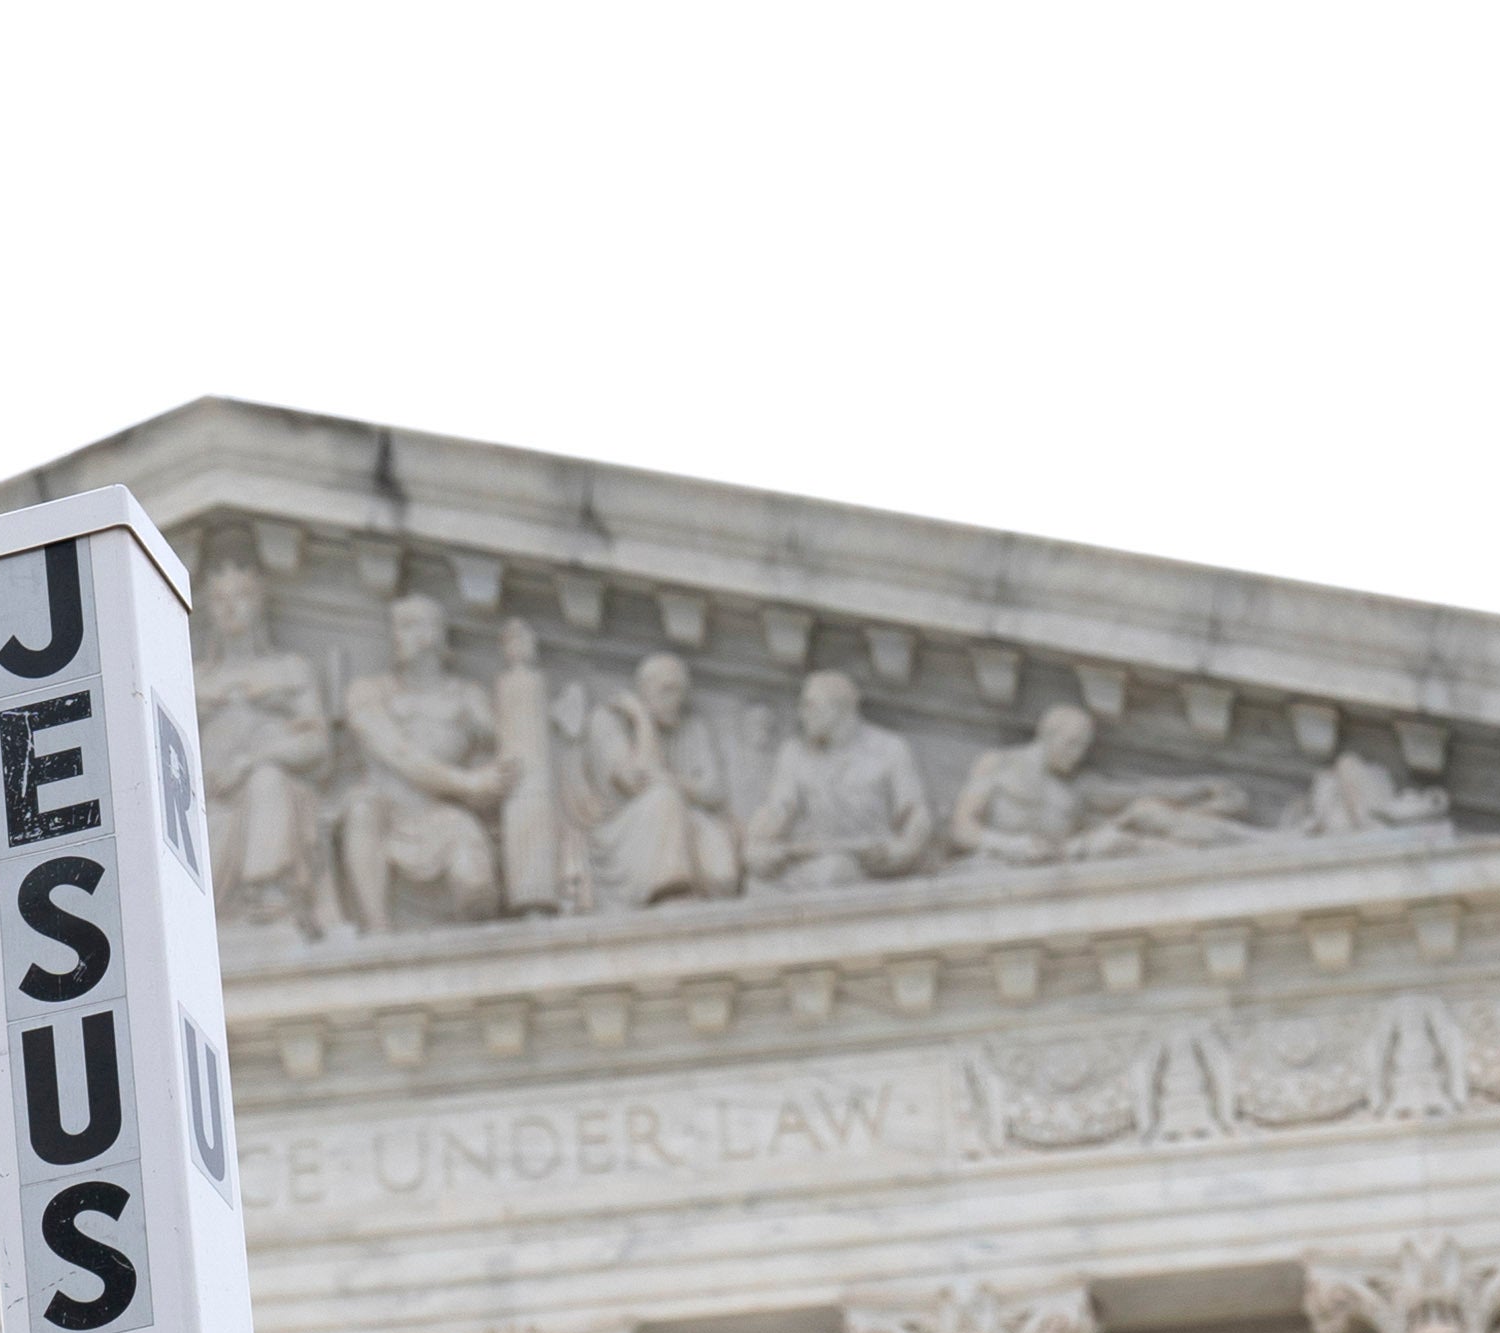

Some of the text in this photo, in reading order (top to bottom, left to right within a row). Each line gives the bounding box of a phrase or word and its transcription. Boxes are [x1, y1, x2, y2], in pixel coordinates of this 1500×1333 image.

[156, 700, 201, 871] R
[182, 1017, 225, 1183] U
[371, 1101, 686, 1196] UNDER
[716, 1079, 895, 1164] LAW
